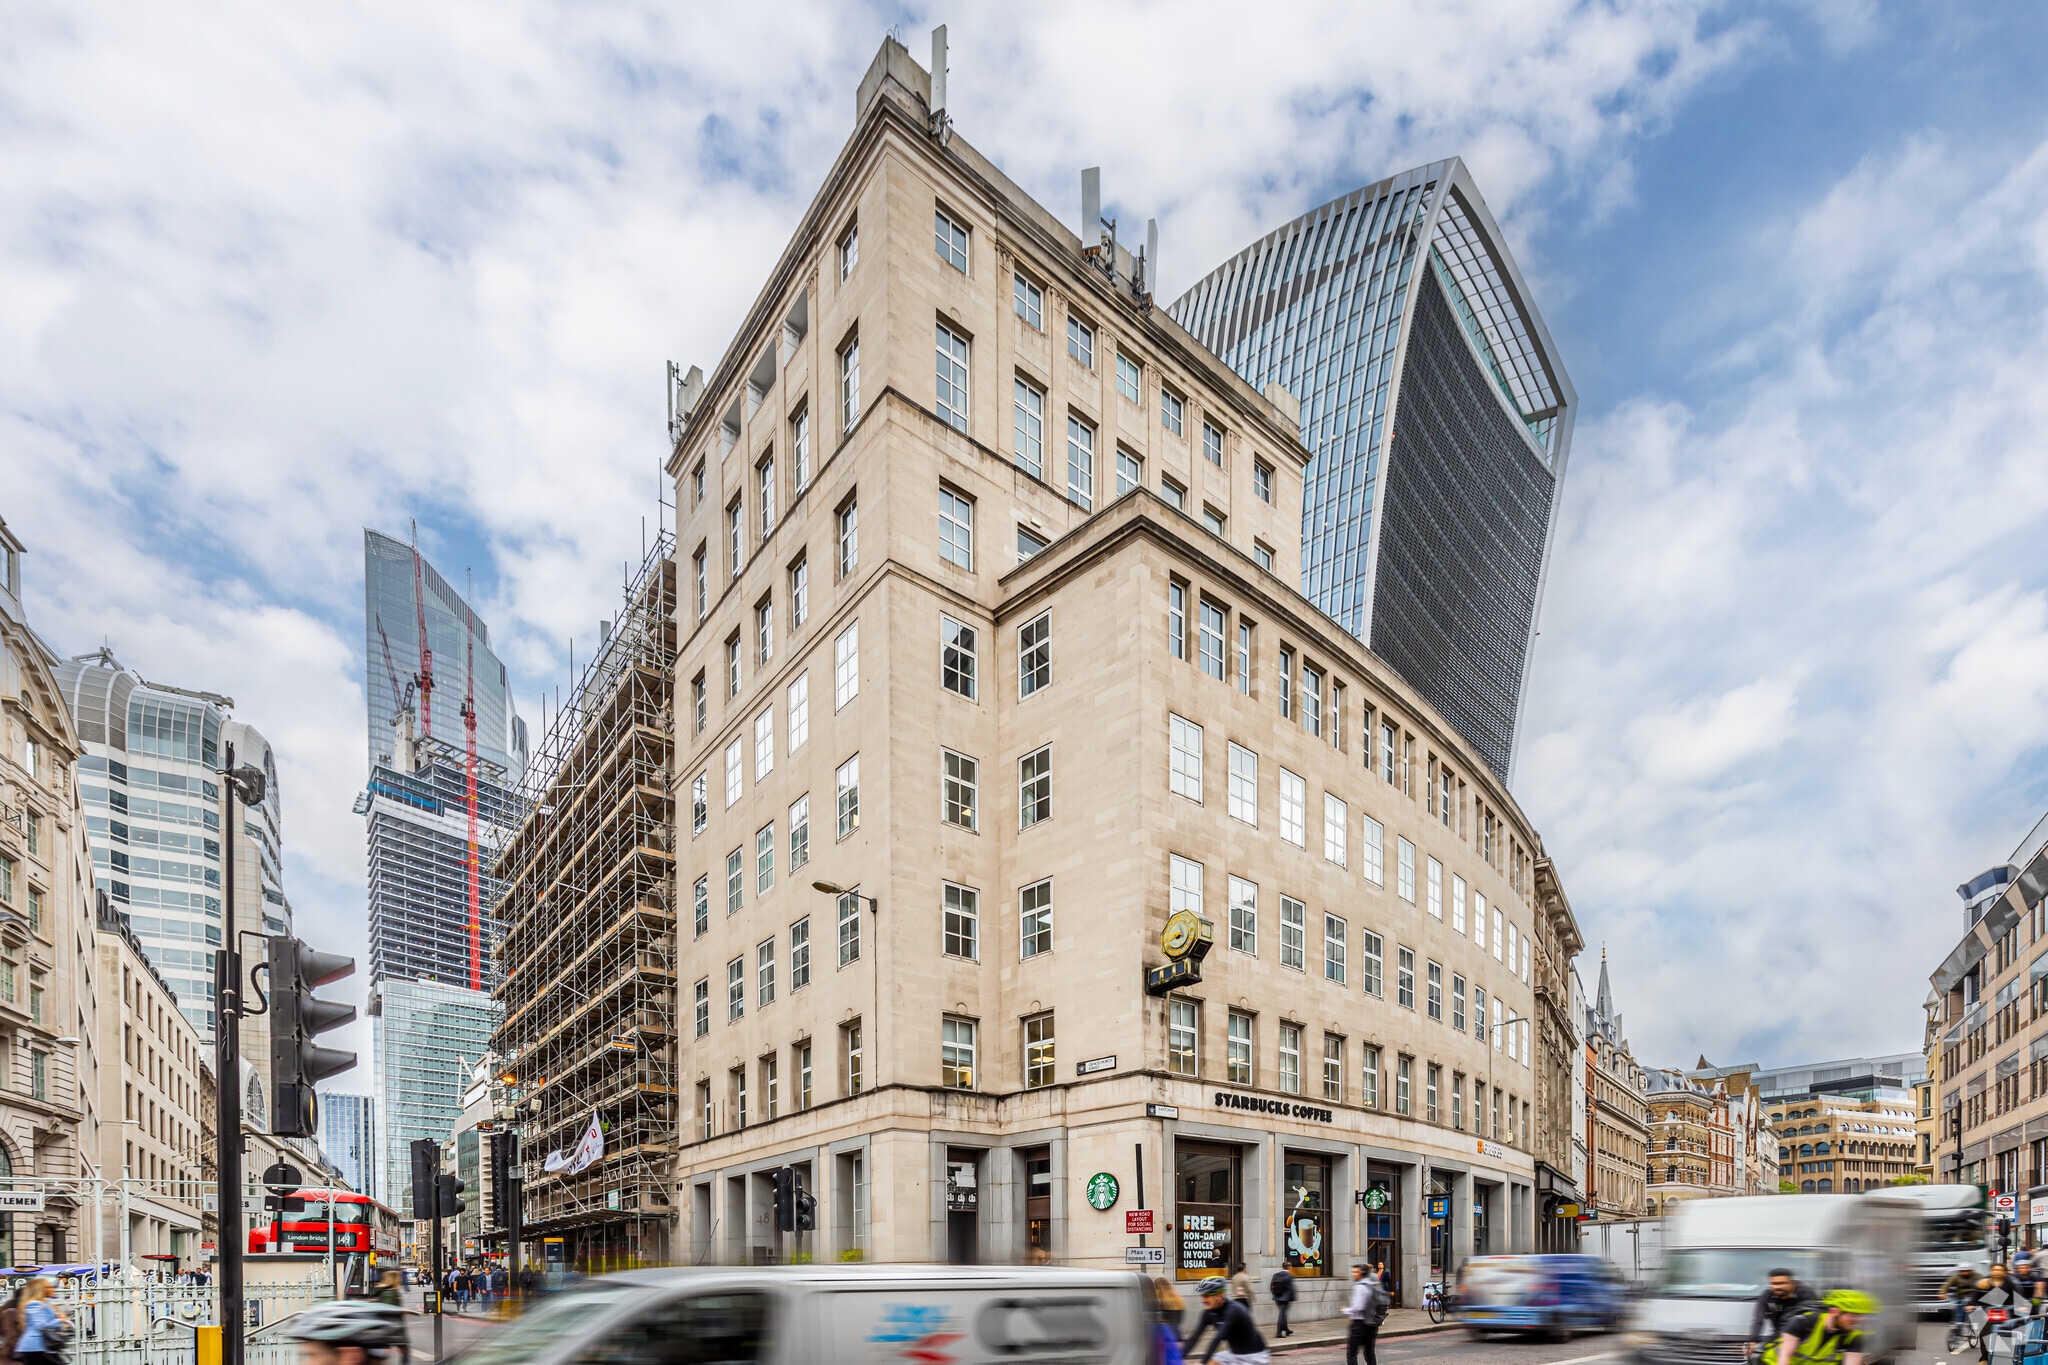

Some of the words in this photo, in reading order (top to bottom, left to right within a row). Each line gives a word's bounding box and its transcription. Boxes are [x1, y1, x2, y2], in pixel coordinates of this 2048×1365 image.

[1214, 1092, 1290, 1116] STARBUCKS
[1292, 1104, 1333, 1123] COFFEE
[756, 1212, 770, 1224] 48
[1183, 1215, 1215, 1230] FREE
[1183, 1231, 1226, 1240] NON-DAIRY
[1183, 1241, 1214, 1249] CHOICES
[1148, 1250, 1162, 1261] 15
[1183, 1250, 1191, 1259] IN
[1192, 1250, 1213, 1259] YOUR
[1183, 1259, 1207, 1268] USUAL
